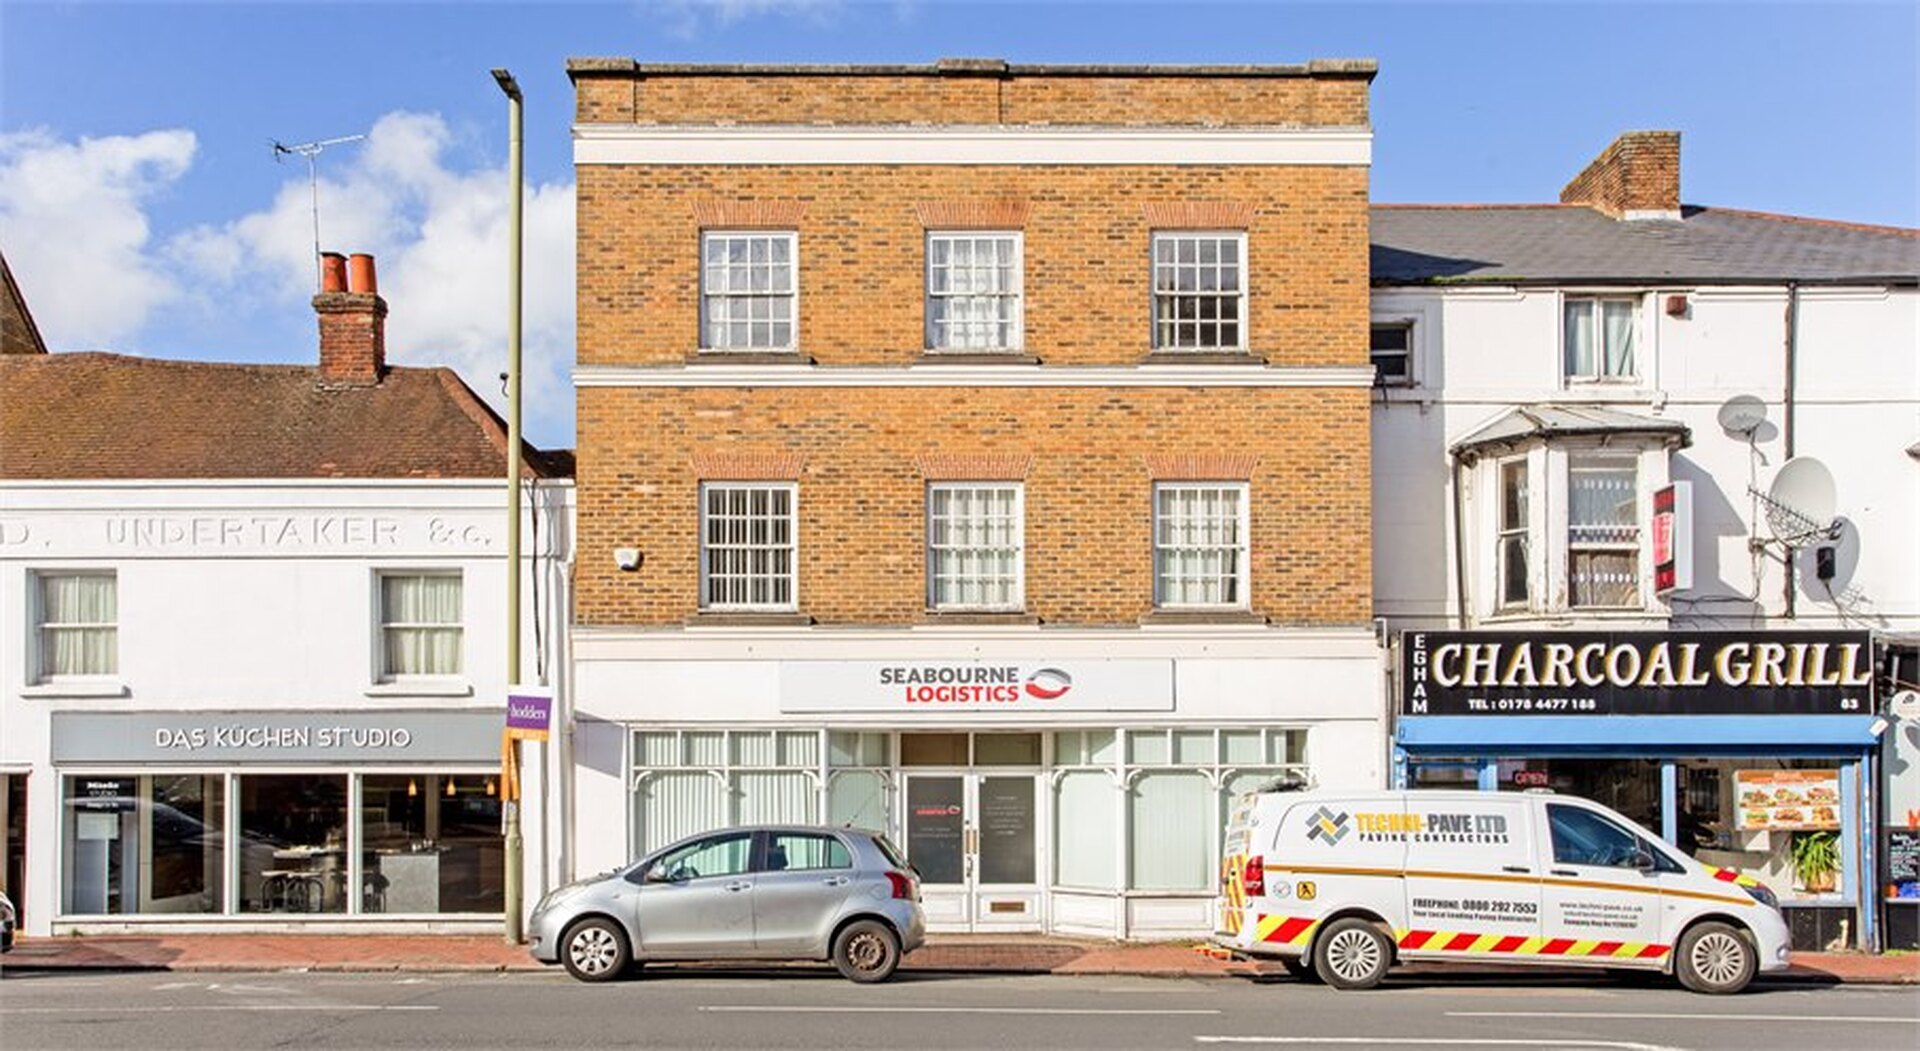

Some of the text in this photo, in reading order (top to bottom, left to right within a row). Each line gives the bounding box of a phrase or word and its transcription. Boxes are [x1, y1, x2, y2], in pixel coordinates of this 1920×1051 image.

[106, 517, 399, 546] UNDERTAKER
[1432, 641, 1872, 687] CHARCOAL GRILL
[880, 667, 1019, 684] SEABOURNE
[1412, 634, 1428, 713] EGHAM
[906, 685, 1019, 703] LOGISTICS
[1498, 699, 1531, 710] 0178
[1535, 699, 1568, 710] 4477
[1572, 699, 1596, 710] 188
[1840, 698, 1859, 710] 83
[155, 724, 412, 750] DAS KÜCHEN STUDIO
[1355, 813, 1508, 833] TECHNI-PAVE LTD
[1359, 833, 1509, 844] PAVING CONTRACTORS
[1462, 899, 1490, 911] 0800
[1491, 900, 1511, 912] 292
[1512, 902, 1537, 914] 7553
